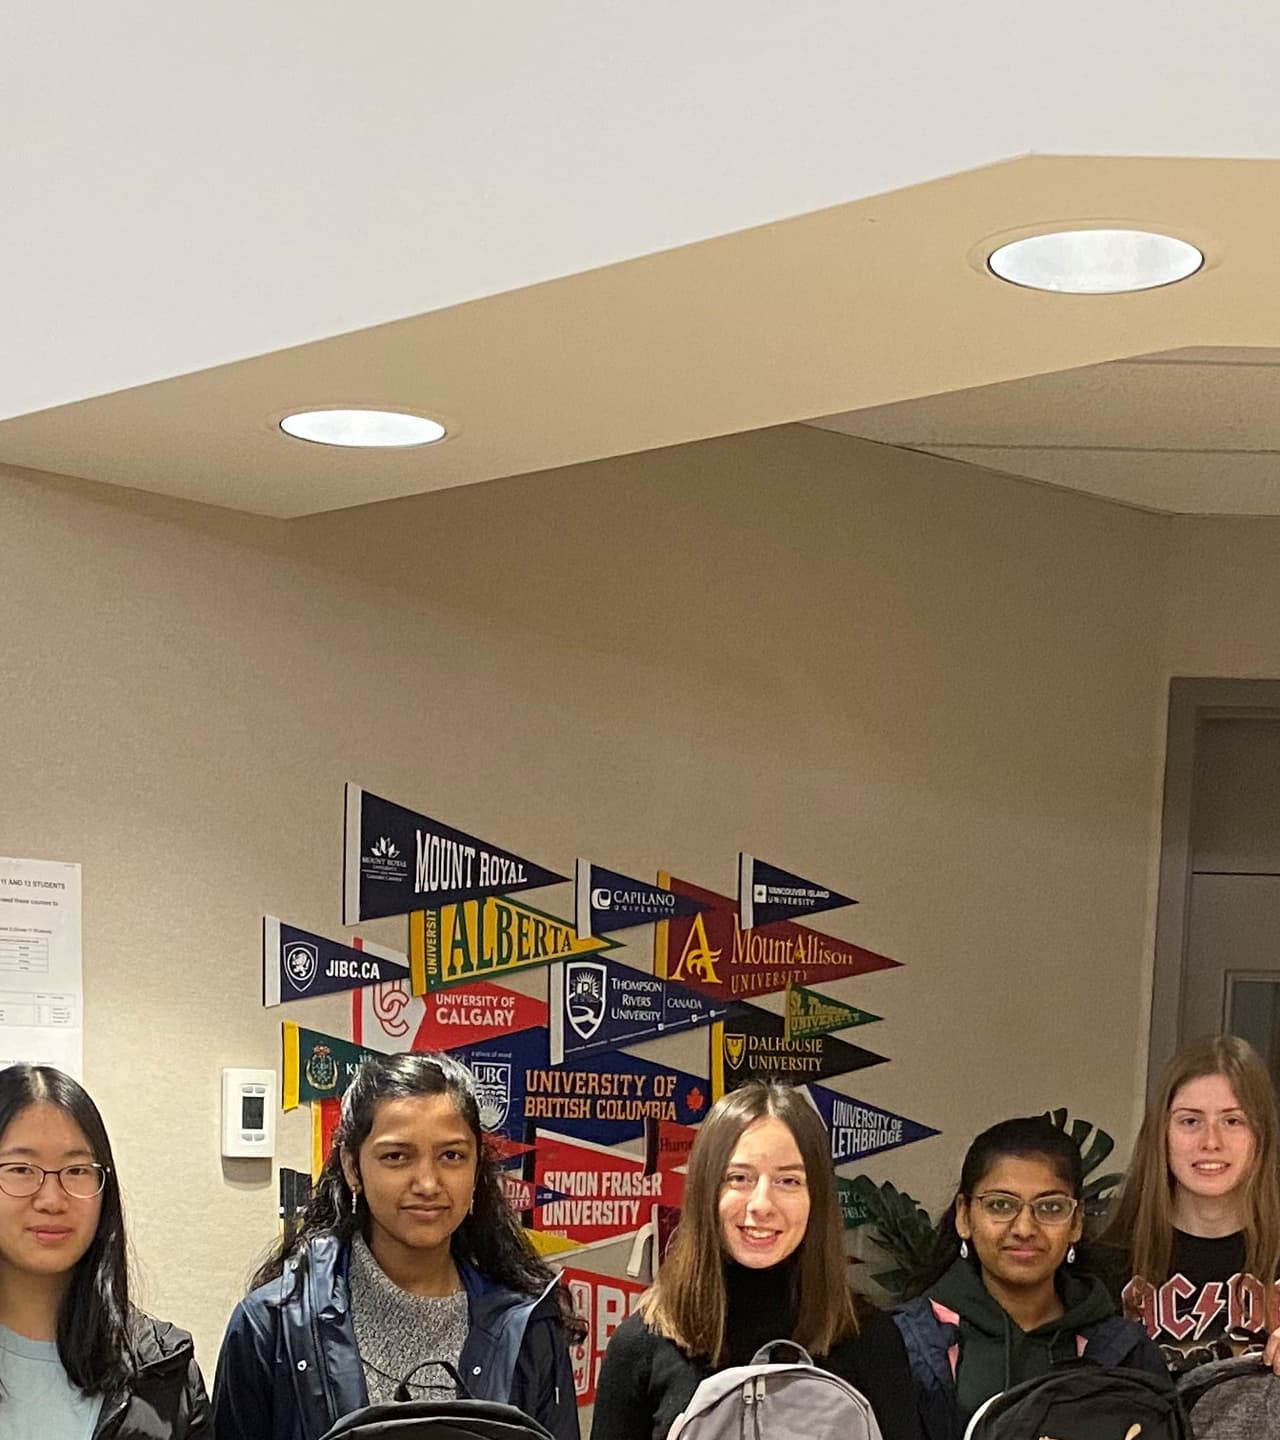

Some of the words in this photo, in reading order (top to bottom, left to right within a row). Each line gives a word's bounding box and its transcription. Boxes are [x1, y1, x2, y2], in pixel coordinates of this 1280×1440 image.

[415, 829, 475, 893] MOUNT
[479, 851, 527, 887] ROYAL
[613, 890, 675, 907] CAPILANO
[426, 910, 437, 975] UNIVERSIT
[447, 898, 572, 977] ALBERTA
[326, 960, 380, 979] JIBC.CA
[611, 977, 663, 993] THOMPSON
[435, 993, 498, 1007] UNIVERSITY
[501, 996, 515, 1007] OF
[622, 994, 651, 1007] RIVERS
[667, 997, 703, 1010] CANADA
[435, 1008, 515, 1027] CALGARY
[611, 1008, 662, 1022] UNIVERSITY
[749, 1034, 822, 1053] DALHOUSIE
[749, 1054, 822, 1072] UNIVERSITY
[474, 1066, 507, 1084] UBC
[525, 1069, 647, 1097] UNIVERSITY
[653, 1075, 677, 1097] OF
[524, 1096, 591, 1119] BRITISH
[596, 1100, 676, 1121] COLUMBIA
[832, 1099, 890, 1130] UNIVERSITY
[891, 1119, 903, 1130] OF
[831, 1127, 903, 1158] LETHBRIDGE
[543, 1171, 599, 1197] SIMON
[602, 1172, 662, 1197] FRASER
[542, 1201, 641, 1226] UNIVERSITY
